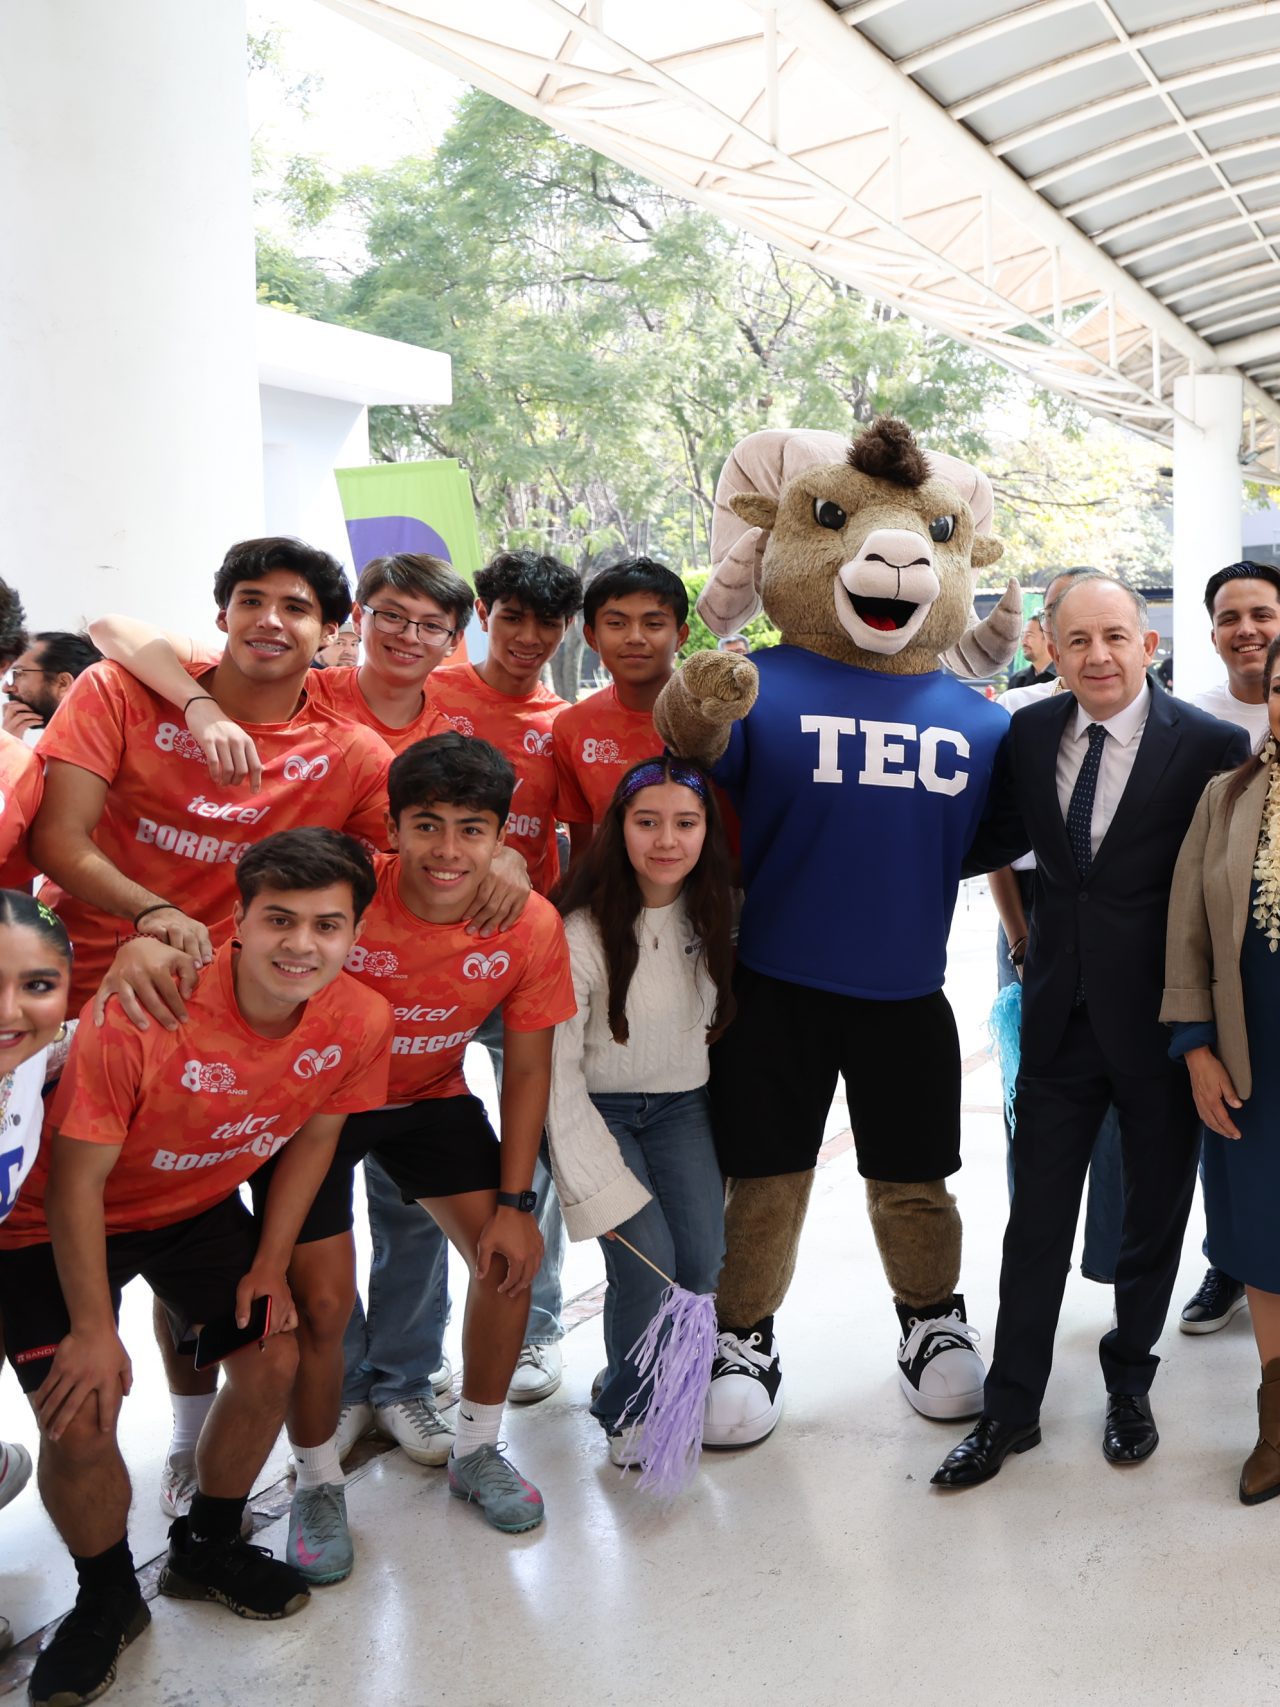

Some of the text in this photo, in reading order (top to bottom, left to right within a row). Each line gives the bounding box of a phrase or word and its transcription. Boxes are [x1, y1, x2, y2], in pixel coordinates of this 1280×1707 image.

[800, 715, 970, 797] TEC
[187, 795, 271, 825] telcel
[136, 817, 252, 865] BORREG
[390, 1004, 459, 1021] elcel
[391, 1025, 480, 1055] REGOS
